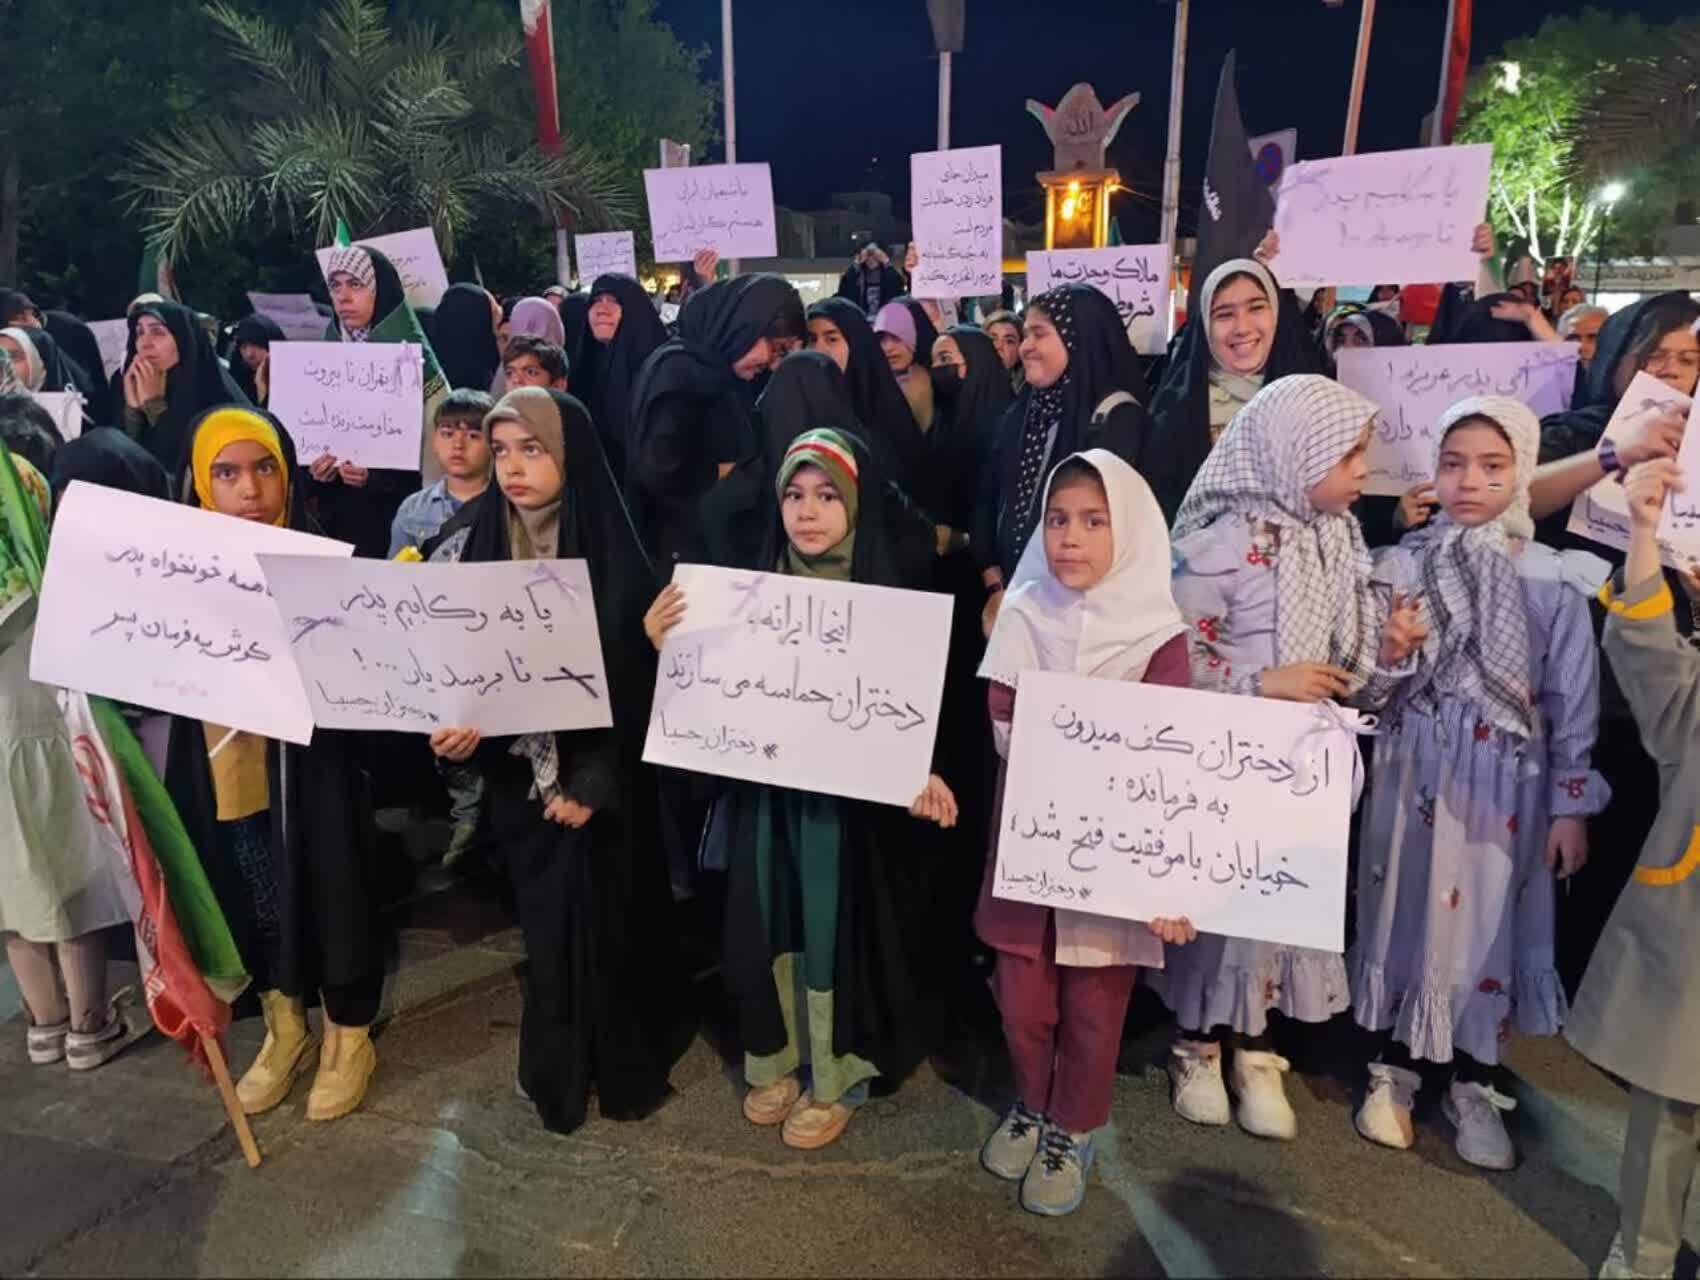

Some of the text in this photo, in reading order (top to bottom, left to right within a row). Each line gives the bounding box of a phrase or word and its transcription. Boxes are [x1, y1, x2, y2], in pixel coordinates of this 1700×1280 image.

[1046, 254, 1160, 285] ملاک وحدت ما
[303, 361, 341, 390] بیروت
[344, 361, 355, 383] تا
[358, 360, 390, 392] تهران
[298, 401, 329, 426] است
[351, 412, 403, 438] مقاومت
[104, 545, 145, 578] پدر
[151, 548, 222, 583] خونخواه
[339, 583, 553, 633] پا به رکابیم پدر
[142, 618, 192, 649] فرمان
[818, 599, 853, 654] اینجا
[439, 663, 505, 697] برسد
[505, 649, 532, 684] تا
[665, 645, 926, 731] دختران حماسه می سازند
[1051, 703, 1329, 797] از دختران کف میدون
[1206, 796, 1230, 824] به
[1068, 815, 1105, 873] فتح
[1111, 827, 1186, 878] موفقیت
[1187, 830, 1202, 881] با
[1207, 838, 1310, 896] خیابان
